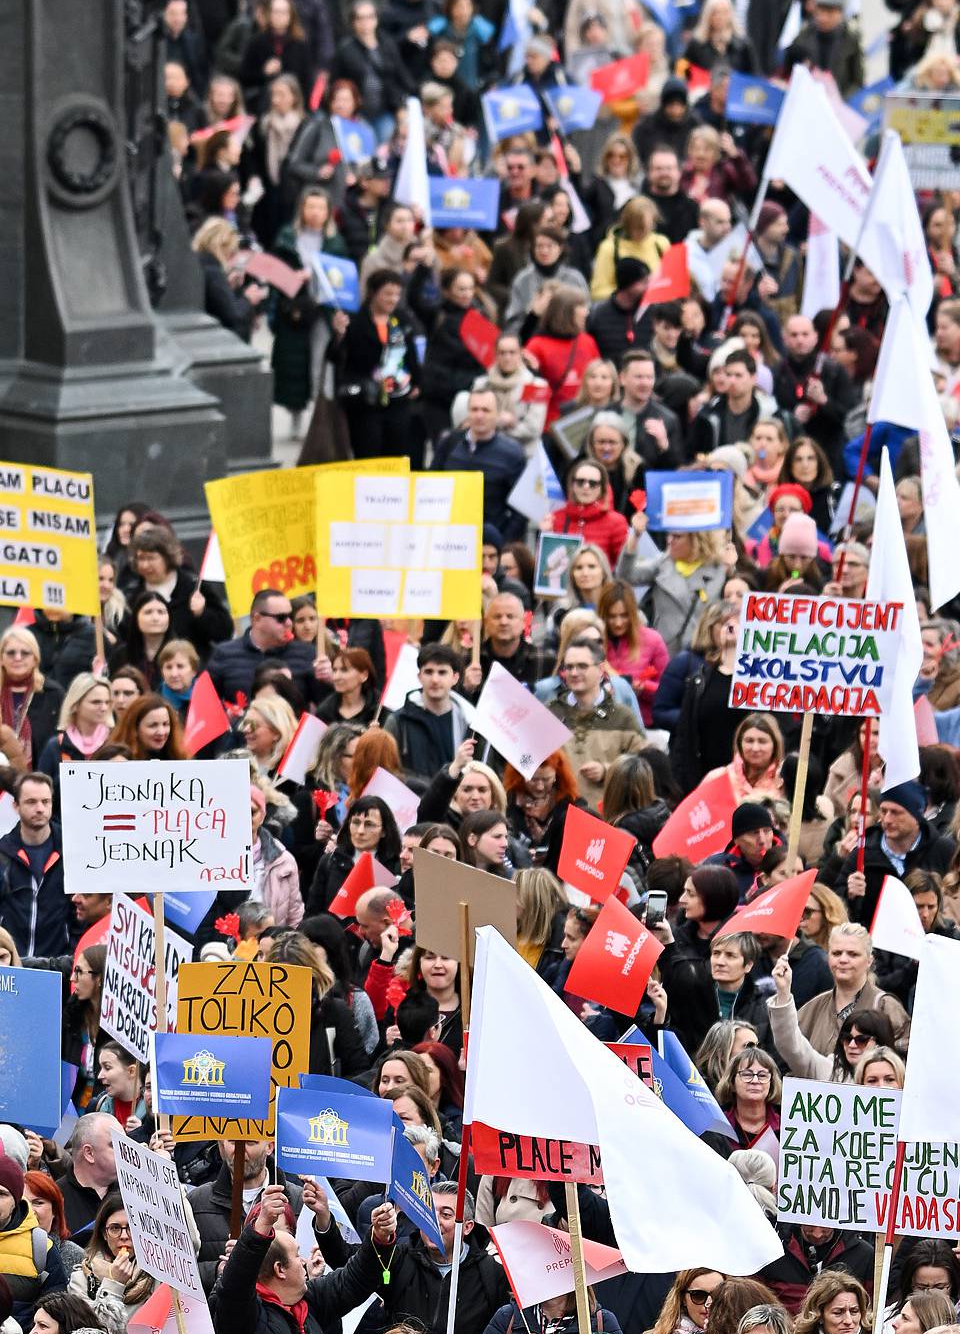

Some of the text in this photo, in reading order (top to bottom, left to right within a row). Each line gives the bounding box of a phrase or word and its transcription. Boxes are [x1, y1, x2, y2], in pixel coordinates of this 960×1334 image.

[32, 475, 90, 500] PLAĆU
[32, 511, 90, 534] NISAM
[746, 595, 904, 632] KOEFICIJENT
[742, 628, 880, 662] INFLACIJA
[736, 653, 884, 687] ŠKOLSTVU
[731, 681, 882, 715] DEGRADACIJA
[86, 836, 206, 868] JEDNAK
[575, 858, 604, 881] PREPOROD
[113, 902, 137, 949] SVI
[621, 931, 649, 976] PREPOROD
[105, 964, 150, 1026] NA KRAJU
[213, 963, 290, 999] ZAR
[101, 994, 114, 1026] JA
[179, 996, 295, 1035] TOLIKO
[789, 1091, 895, 1127] AKO ME
[782, 1127, 820, 1152] ZA
[119, 1169, 160, 1209] NAPRAVILI
[162, 1165, 179, 1189] STE
[783, 1153, 835, 1184] PITA
[917, 1167, 948, 1197] ĆU
[777, 1184, 867, 1224] SAMO JE
